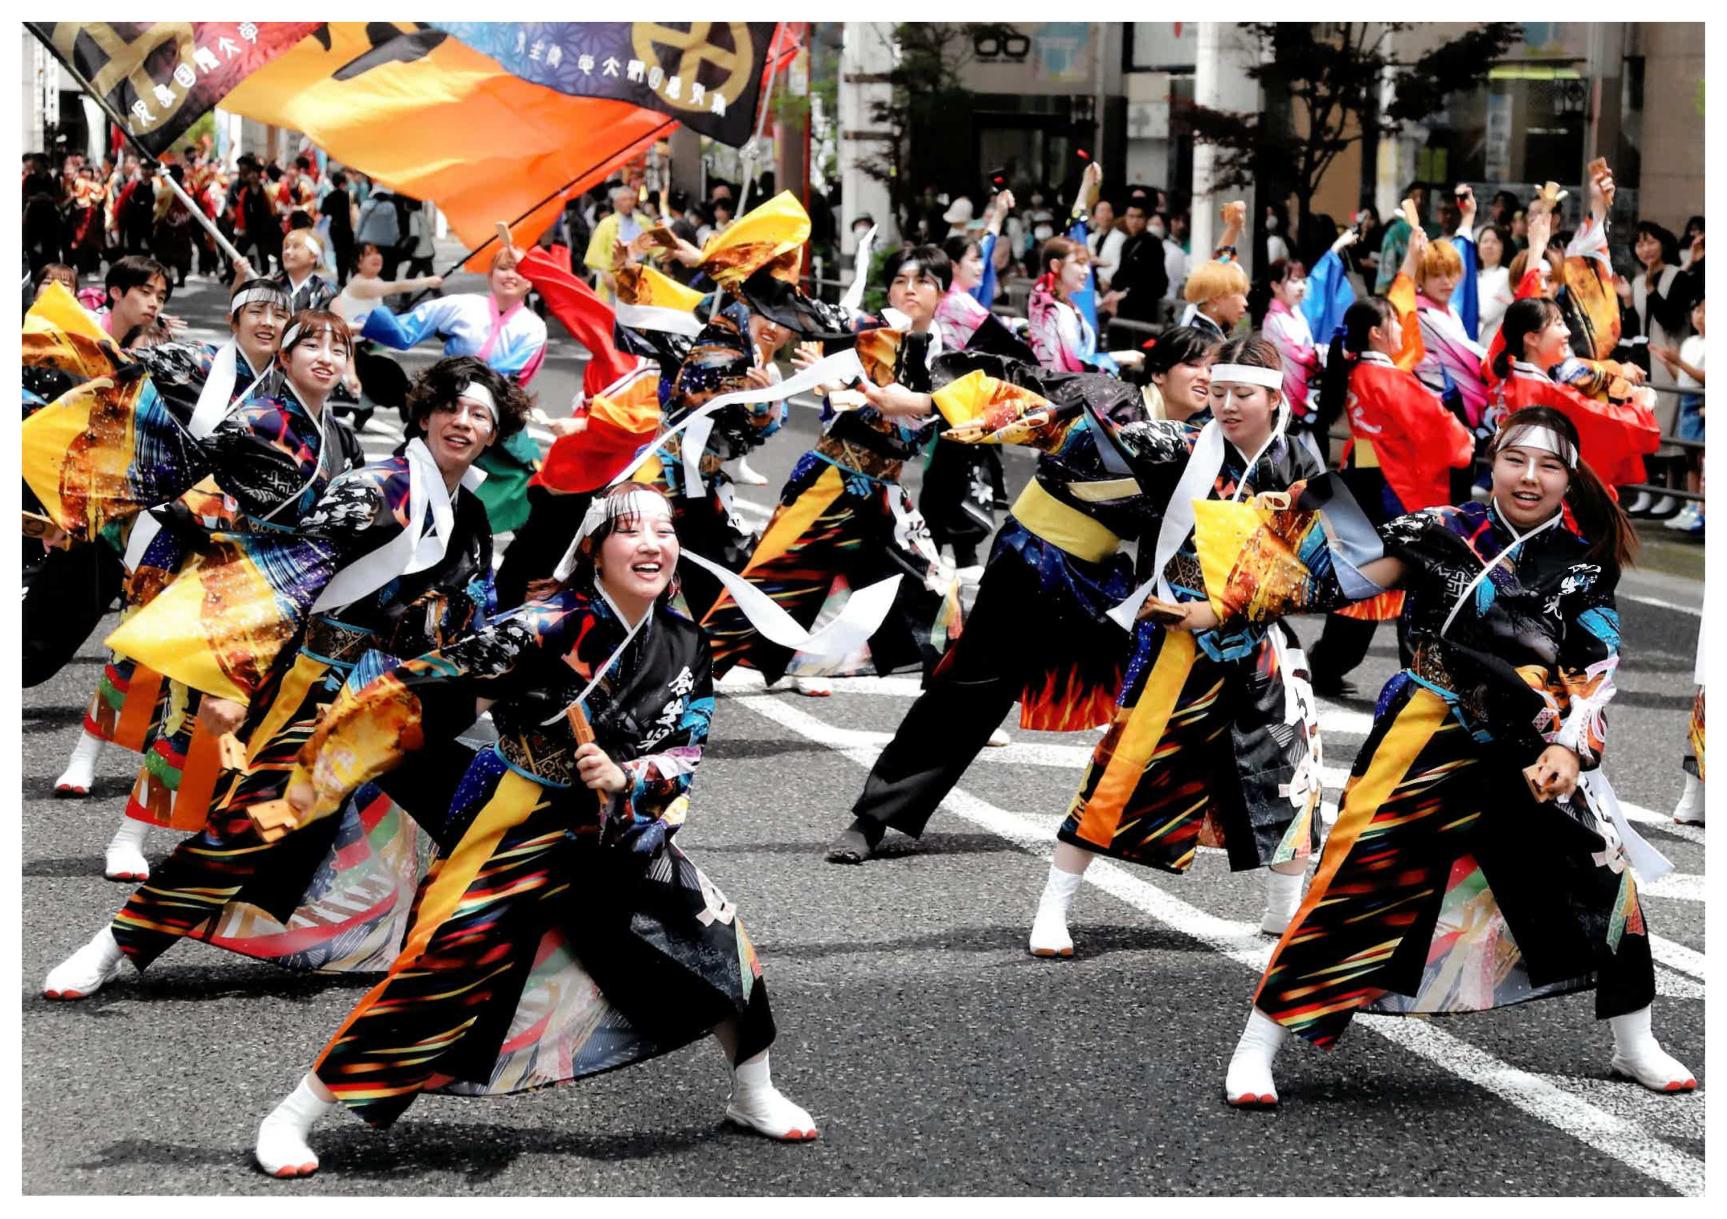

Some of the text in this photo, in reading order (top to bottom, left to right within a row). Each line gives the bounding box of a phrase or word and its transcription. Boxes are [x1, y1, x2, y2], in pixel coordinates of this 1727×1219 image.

[128, 22, 258, 134] 児島国際大学
